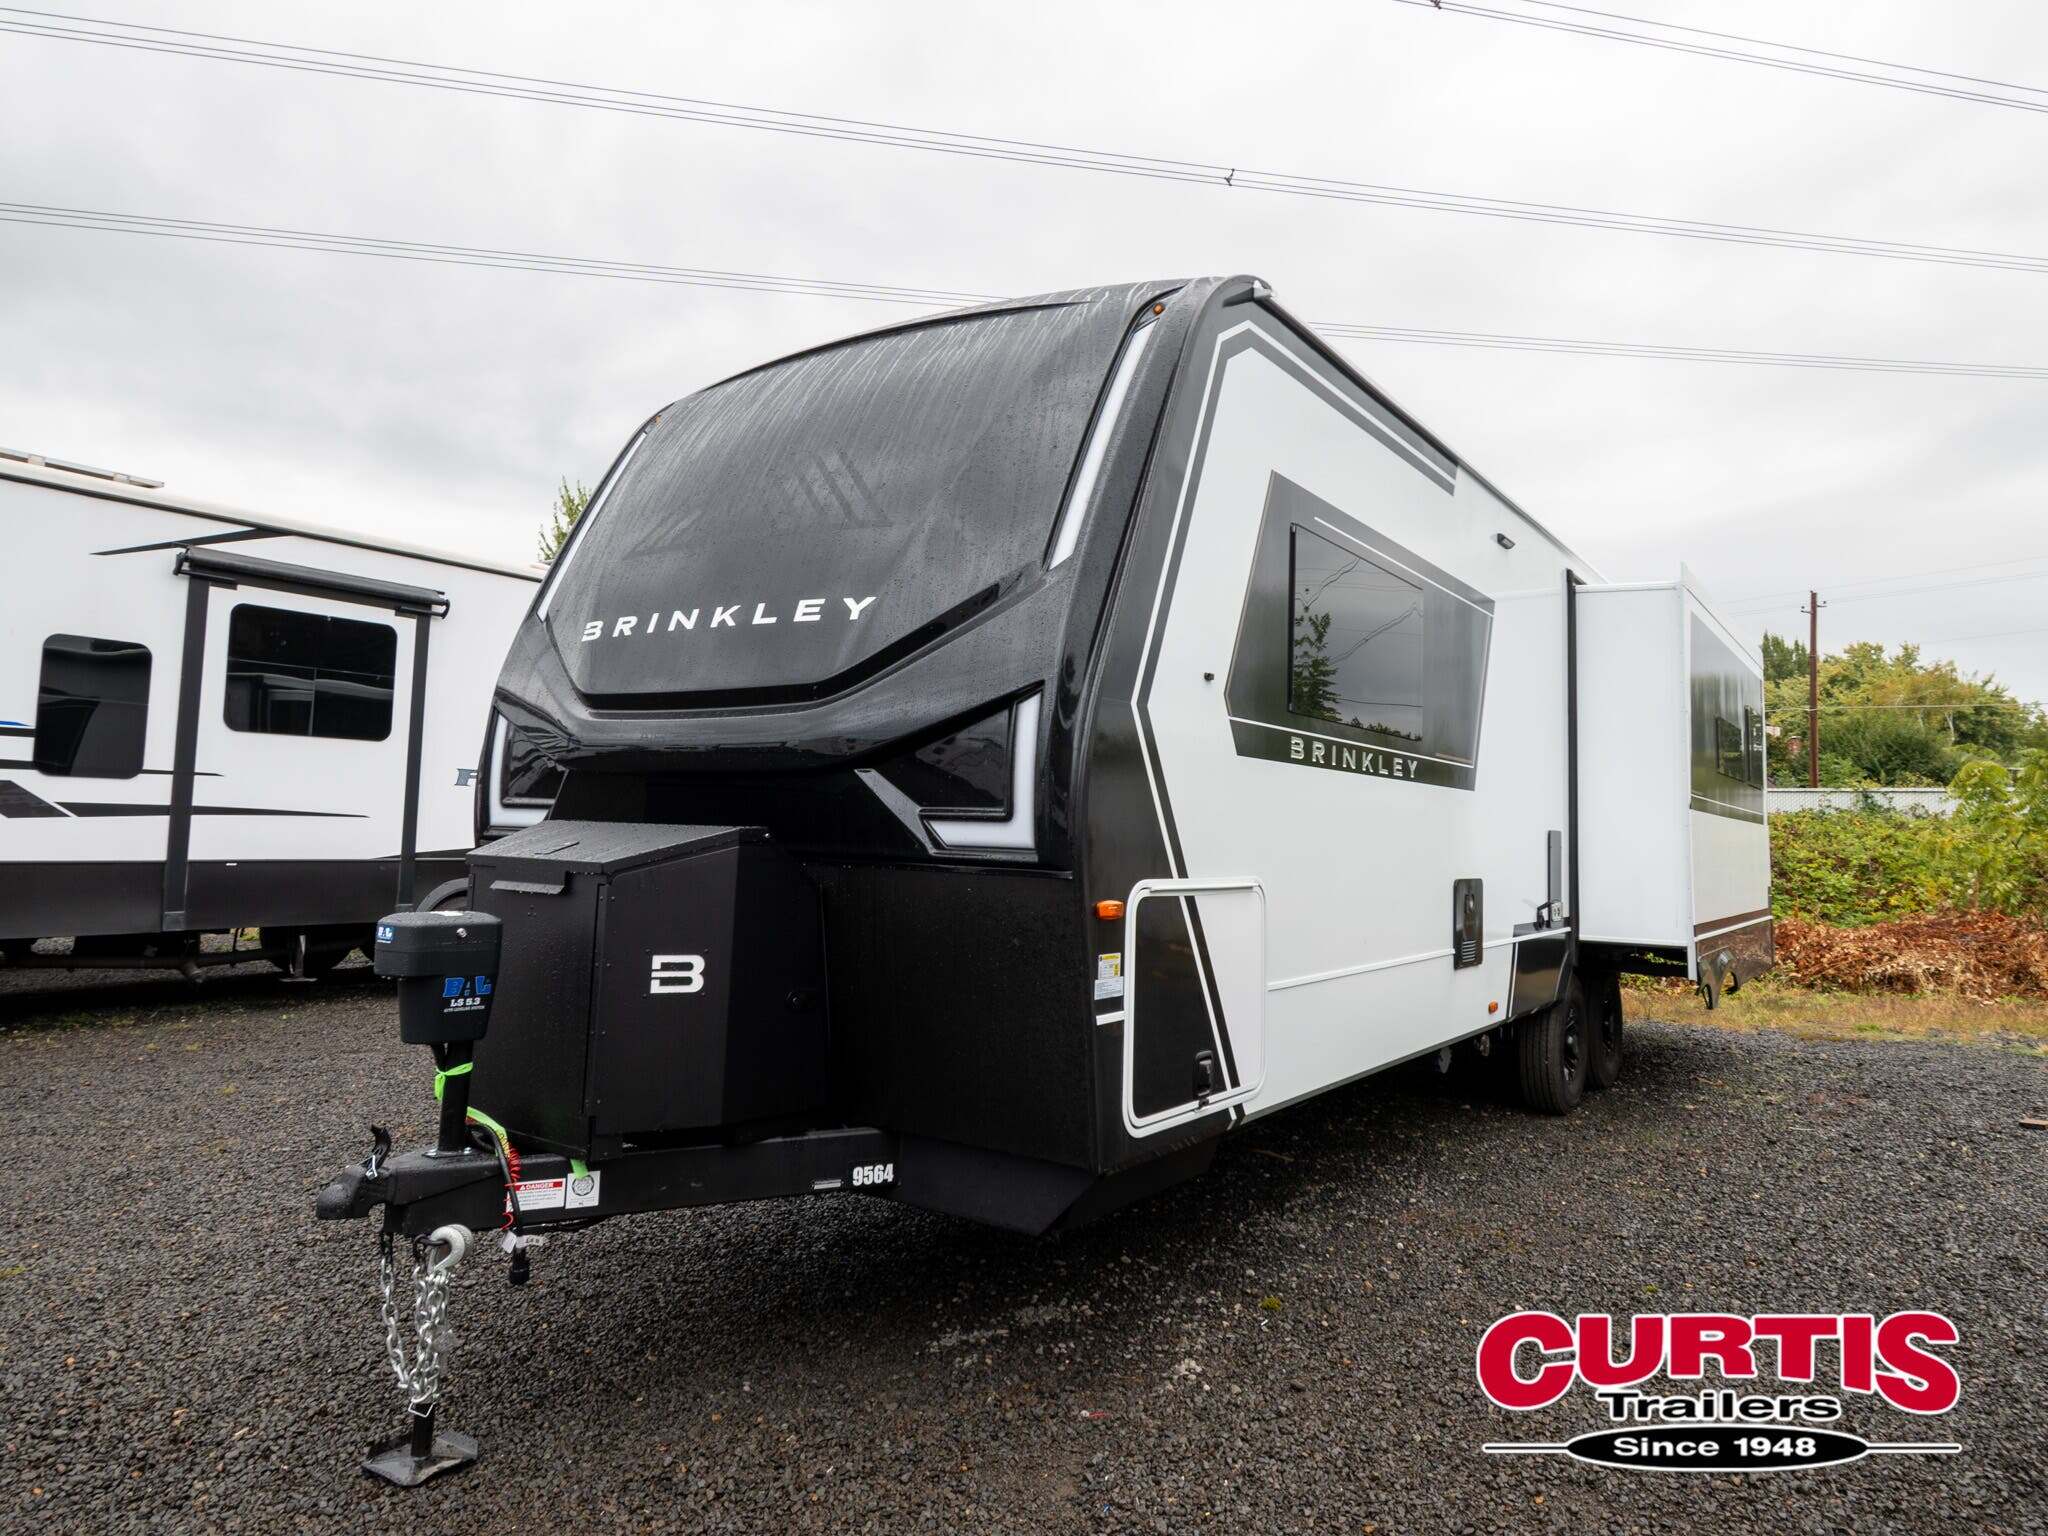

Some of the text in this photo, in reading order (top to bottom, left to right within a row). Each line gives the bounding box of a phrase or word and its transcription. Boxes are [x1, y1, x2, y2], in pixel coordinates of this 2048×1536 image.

[581, 596, 877, 642] BRINKLEY
[1290, 736, 1418, 779] BRINKLEY
[650, 955, 705, 993] B
[852, 1163, 894, 1187] 9564
